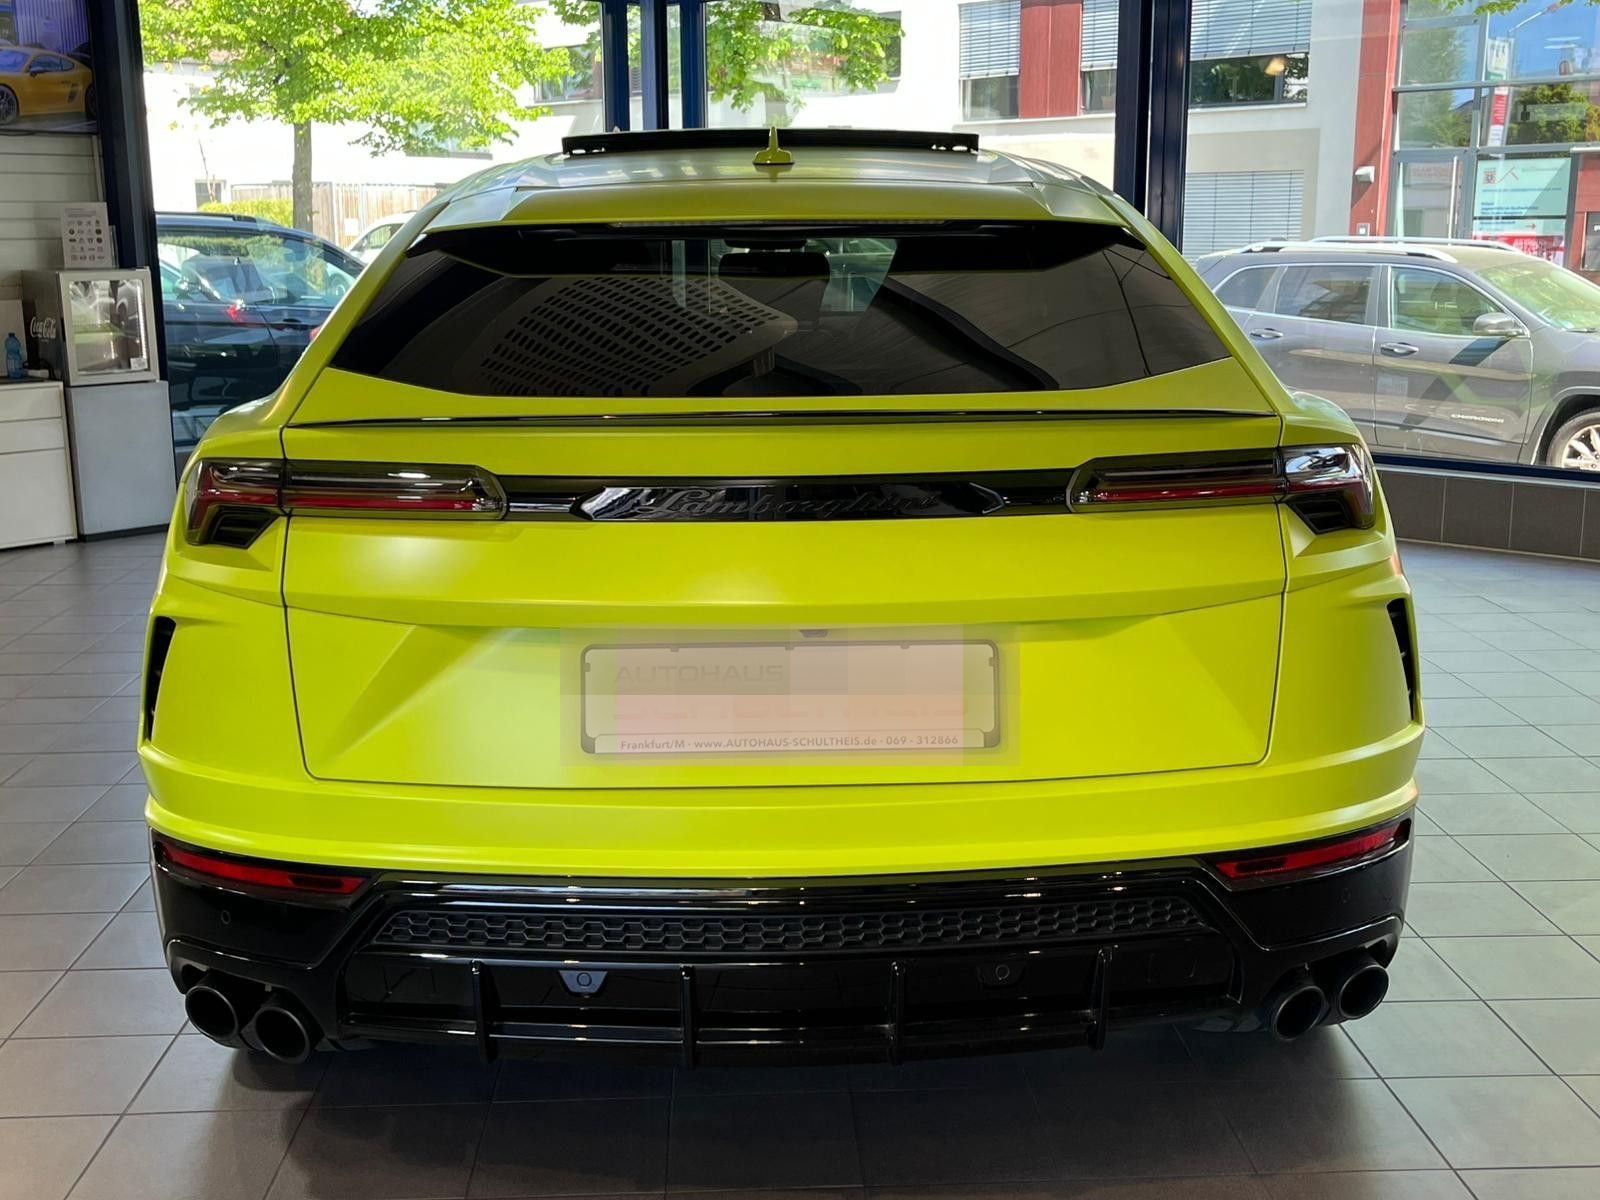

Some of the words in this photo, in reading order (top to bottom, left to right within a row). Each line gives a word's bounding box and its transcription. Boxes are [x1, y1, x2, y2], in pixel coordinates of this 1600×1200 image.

[638, 487, 938, 519] Lamborghini
[613, 665, 784, 683] AUTOHAUS
[620, 740, 685, 750] Frankfurt/M
[694, 736, 877, 748] www.AUTOHAUS-SCHULTHEIS.de
[885, 736, 907, 746] 069
[916, 735, 959, 745] 312866
